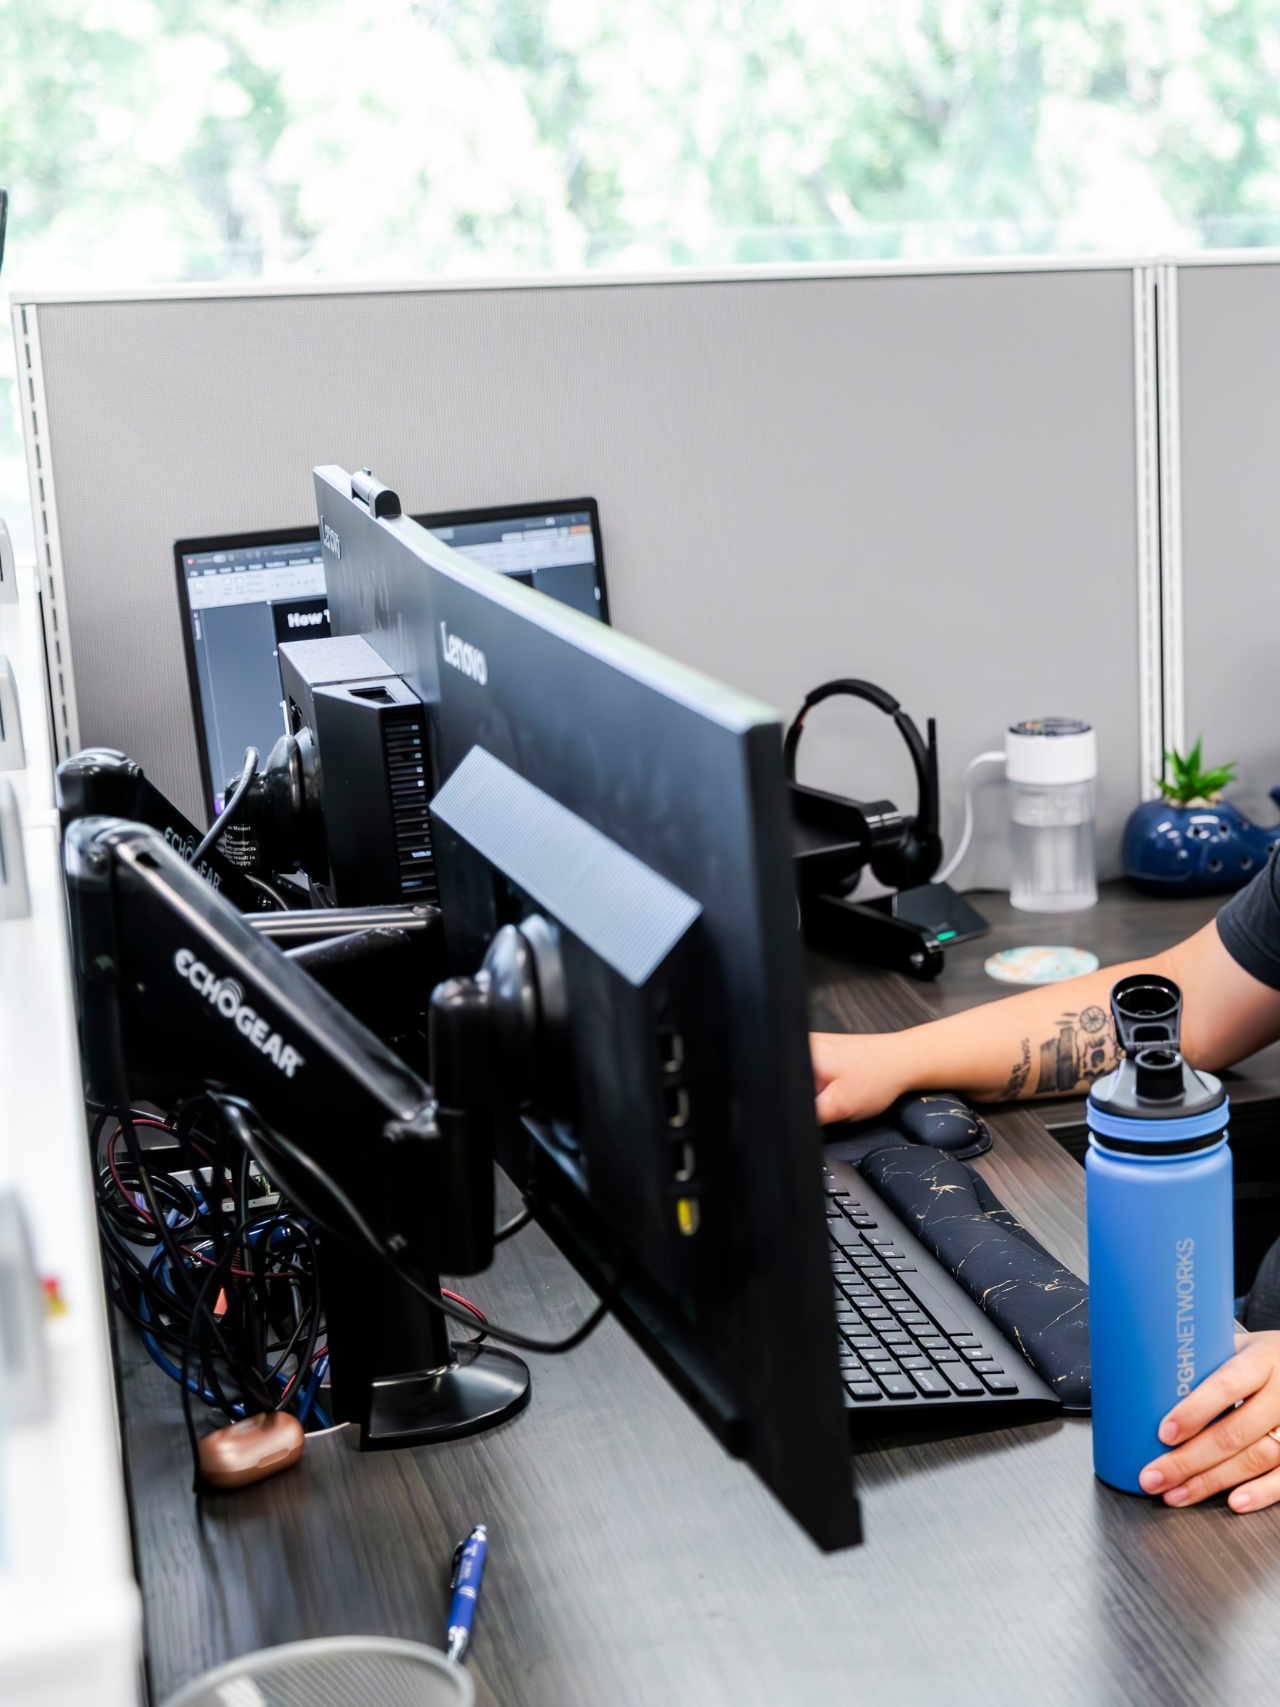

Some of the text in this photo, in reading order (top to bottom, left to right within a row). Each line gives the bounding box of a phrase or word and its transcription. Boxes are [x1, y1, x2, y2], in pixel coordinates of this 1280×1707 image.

[287, 611, 323, 628] How
[440, 620, 488, 686] Lenovo
[174, 948, 302, 1078] ECHOGEAR
[1175, 1237, 1196, 1397] PGHNETWORKS
